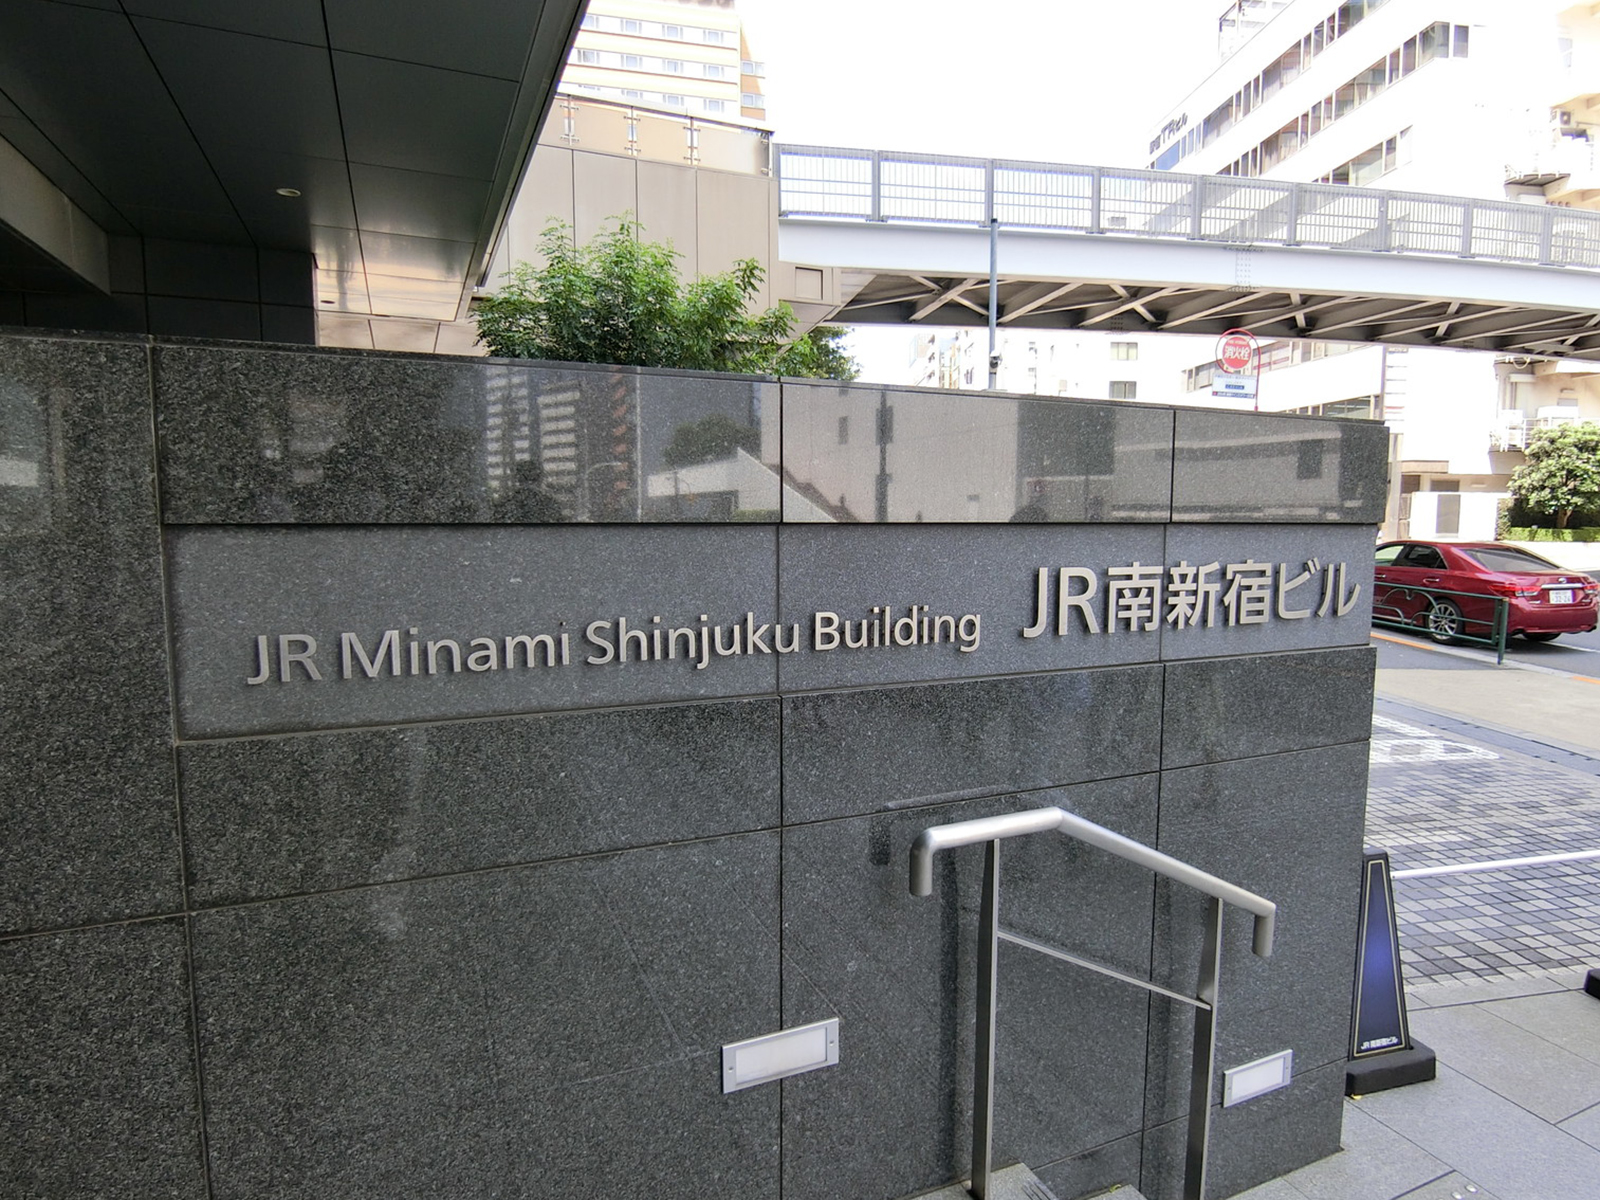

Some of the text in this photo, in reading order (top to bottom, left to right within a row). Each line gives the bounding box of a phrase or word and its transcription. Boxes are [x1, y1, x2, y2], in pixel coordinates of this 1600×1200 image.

[1224, 345, 1250, 360] 消火栓
[1023, 557, 1362, 638] JR南新宿ビル
[246, 605, 981, 686] JR Minami Shinjuku Building
